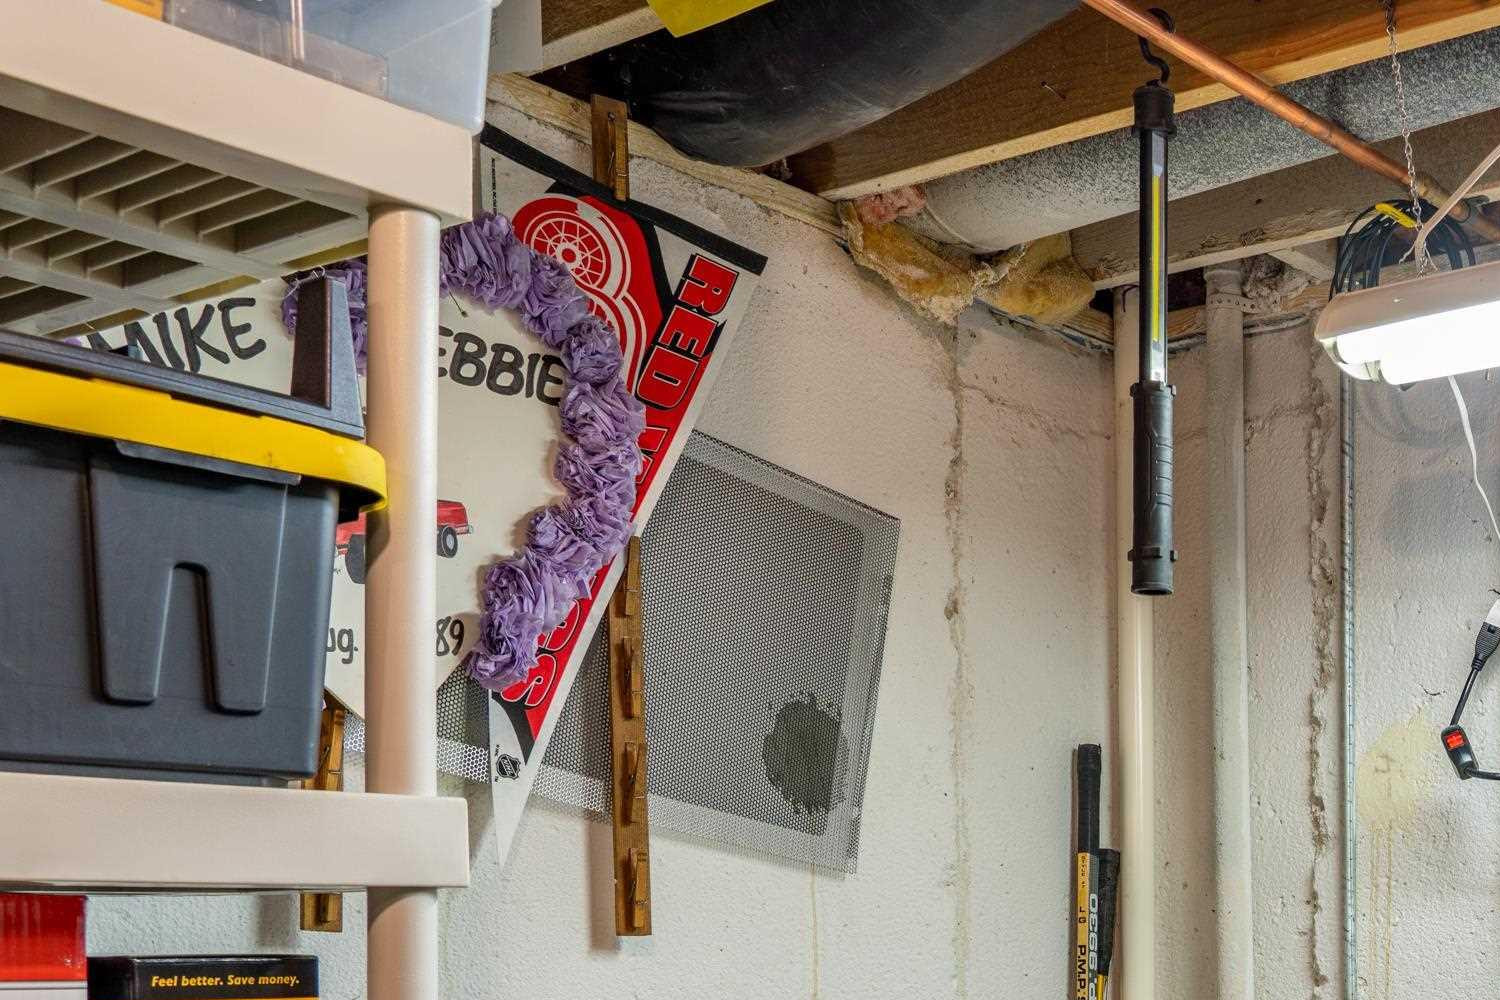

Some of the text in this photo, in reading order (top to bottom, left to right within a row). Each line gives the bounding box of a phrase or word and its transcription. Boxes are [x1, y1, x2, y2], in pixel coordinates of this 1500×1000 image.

[636, 253, 739, 412] RED
[1088, 893, 1098, 971] 9930
[151, 974, 300, 987] Feel better. Save money.
[1077, 944, 1087, 993] P.M.P.
